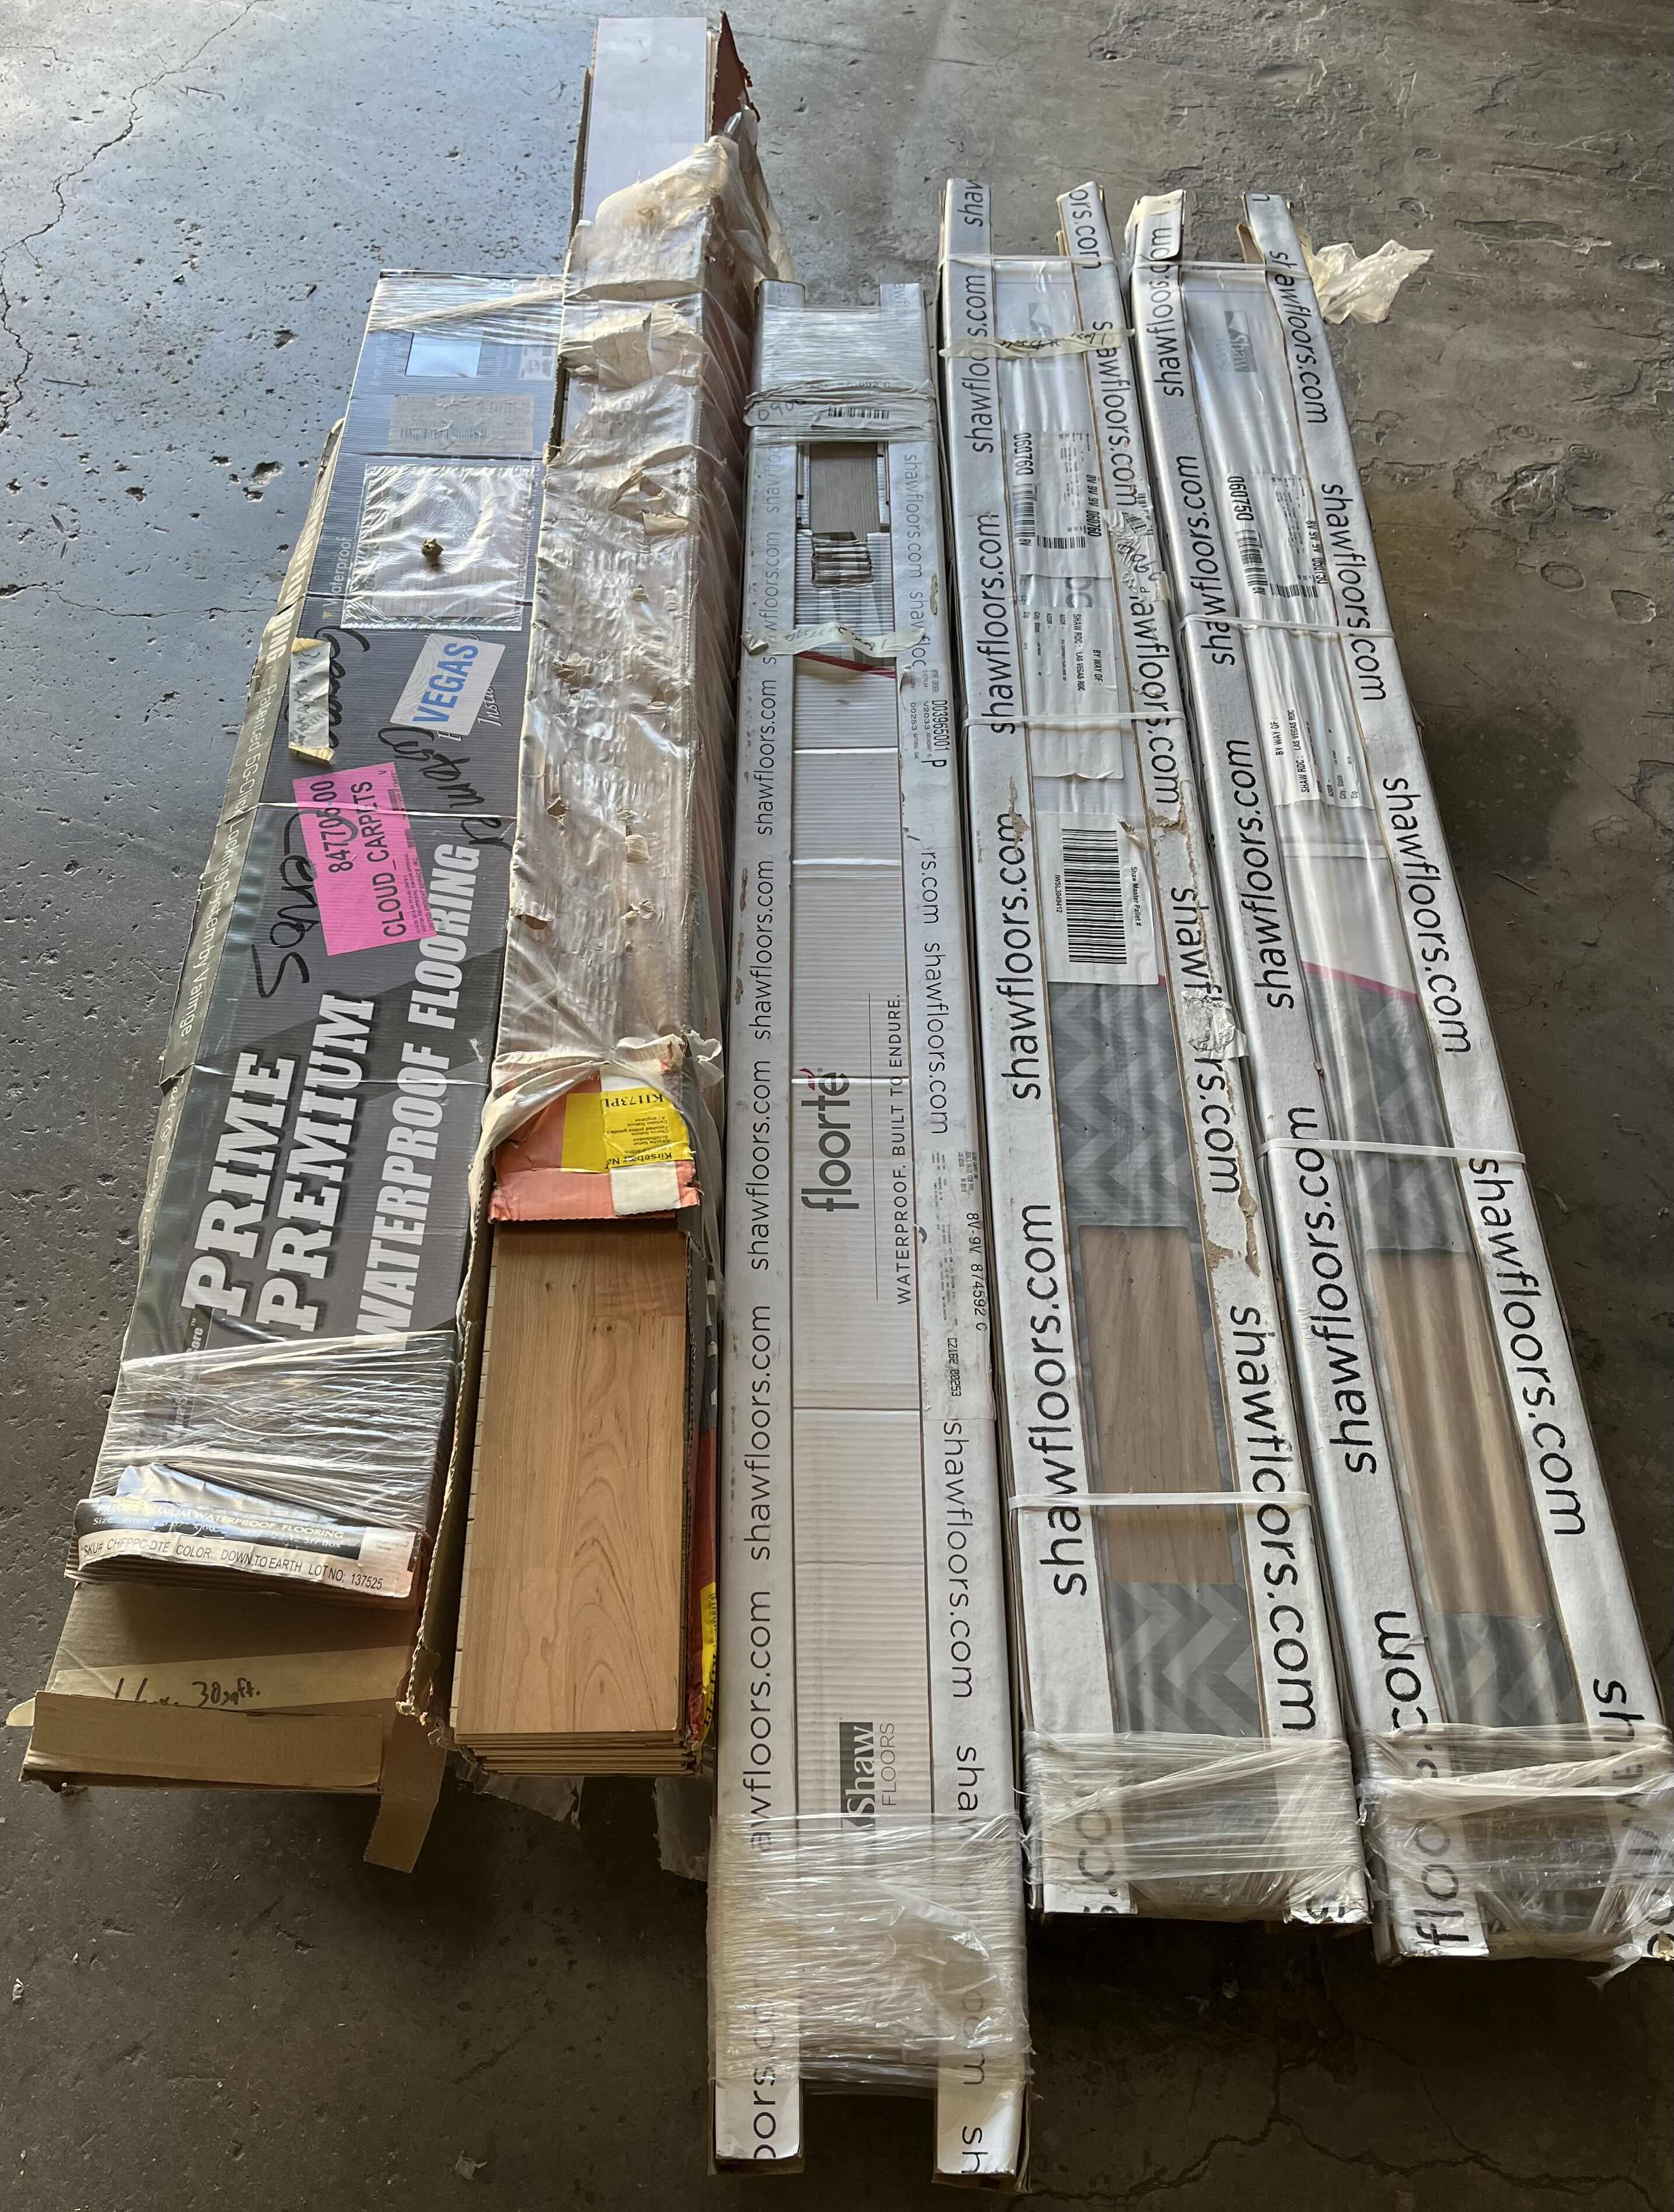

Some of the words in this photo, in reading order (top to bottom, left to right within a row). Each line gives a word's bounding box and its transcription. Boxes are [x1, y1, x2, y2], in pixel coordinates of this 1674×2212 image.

[1092, 320, 1137, 506] sawfloors.com
[1013, 433, 1034, 476] 060760
[904, 454, 925, 578] shawfloors.com
[1087, 510, 1102, 537] 060760
[1227, 476, 1254, 521] 060750
[1018, 537, 1032, 547] 8V
[760, 532, 779, 665] sawfloors.com
[976, 514, 1015, 735] shawfloors.com
[1072, 613, 1082, 630] SHAW
[1074, 632, 1083, 644] RDC
[1075, 652, 1083, 661] LAS
[1092, 649, 1100, 659] BY
[1093, 659, 1102, 673] WAY
[412, 644, 479, 725] VEGAS
[1076, 663, 1085, 679] VEGAS
[1077, 680, 1085, 692] RDC
[1095, 674, 1103, 683] OF
[248, 683, 277, 752] Patented
[1270, 721, 1280, 730] OF
[1272, 731, 1282, 745] WAY
[1287, 709, 1296, 720] RDC
[1289, 721, 1299, 739] VEGAS
[1293, 740, 1302, 751] LAS
[234, 752, 261, 816] 5G-Click
[754, 679, 777, 835] shawfloors.com
[1276, 748, 1284, 756] BY
[1296, 759, 1306, 772] RDC
[1299, 774, 1310, 793] SHAW
[213, 818, 246, 882] Locking
[351, 780, 407, 938] CLOUD_CARPETS
[1227, 739, 1294, 1010] shawfloors.com
[920, 846, 940, 924] rs.com
[1383, 777, 1471, 1053] shawfloors.com
[194, 944, 215, 969] by
[408, 844, 481, 1030] FLOORING
[749, 860, 775, 1040] shawfloors.com
[995, 813, 1041, 1101] shawfloors.com
[888, 994, 902, 1067] ENDURE.
[924, 942, 949, 1134] shawfloors.com
[889, 1076, 903, 1097] TO
[891, 1105, 906, 1156] BUILT
[181, 1052, 295, 1318] PRIME
[256, 994, 375, 1333] PREMIUM
[745, 1060, 771, 1270] shawfloors.com
[354, 1042, 451, 1352] WATERPROOF
[892, 1165, 911, 1305] WATERPROOF.
[967, 1212, 982, 1254] 8V-9V
[970, 1264, 988, 1316] 874592
[1288, 1107, 1377, 1474] shawfloors.com
[975, 1322, 988, 1332] C
[1469, 1157, 1586, 1534] shawfloors.com
[950, 1370, 961, 1397] 00253
[1021, 1205, 1088, 1596] shawfloors.com
[744, 1305, 771, 1560] shawfloors.com
[195, 1511, 277, 1529] WATERPROOF
[281, 1523, 345, 1540] FLOORING
[1230, 1305, 1316, 1730] shawfloors.com
[83, 1542, 104, 1557] SKU#
[175, 1544, 212, 1558] COLOR
[220, 1549, 252, 1567] DOWN
[268, 1557, 303, 1572] EARTH
[308, 1563, 327, 1577] LOT
[351, 1573, 384, 1591] 137525
[943, 1422, 975, 1698] shawfloors.com
[847, 1724, 874, 1817] Shaw
[881, 1722, 896, 1806] FLOORS
